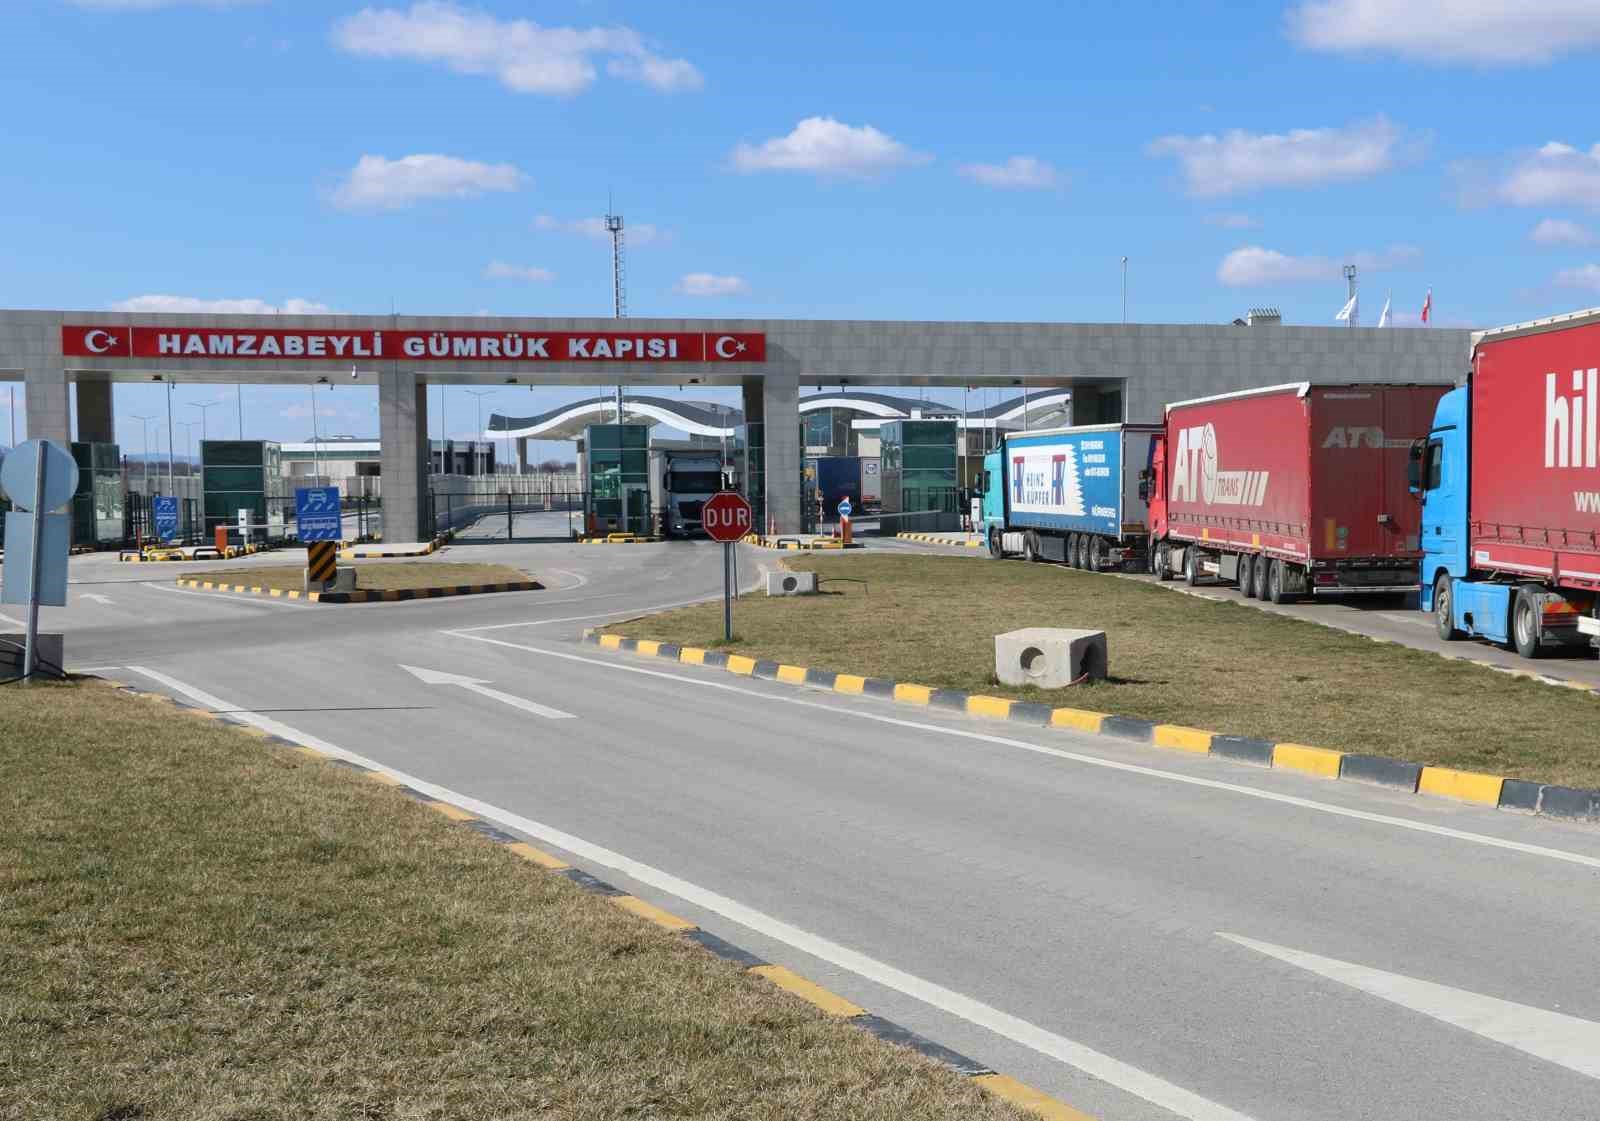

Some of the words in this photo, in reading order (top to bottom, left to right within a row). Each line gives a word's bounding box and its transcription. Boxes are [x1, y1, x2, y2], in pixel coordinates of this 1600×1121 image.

[158, 331, 383, 357] HAMZABEYLİ
[403, 333, 550, 359] GÜMRÜK
[568, 338, 679, 361] KAPISI
[1544, 367, 1600, 468] hil
[1217, 477, 1239, 497] TRANS
[706, 507, 751, 528] DUR
